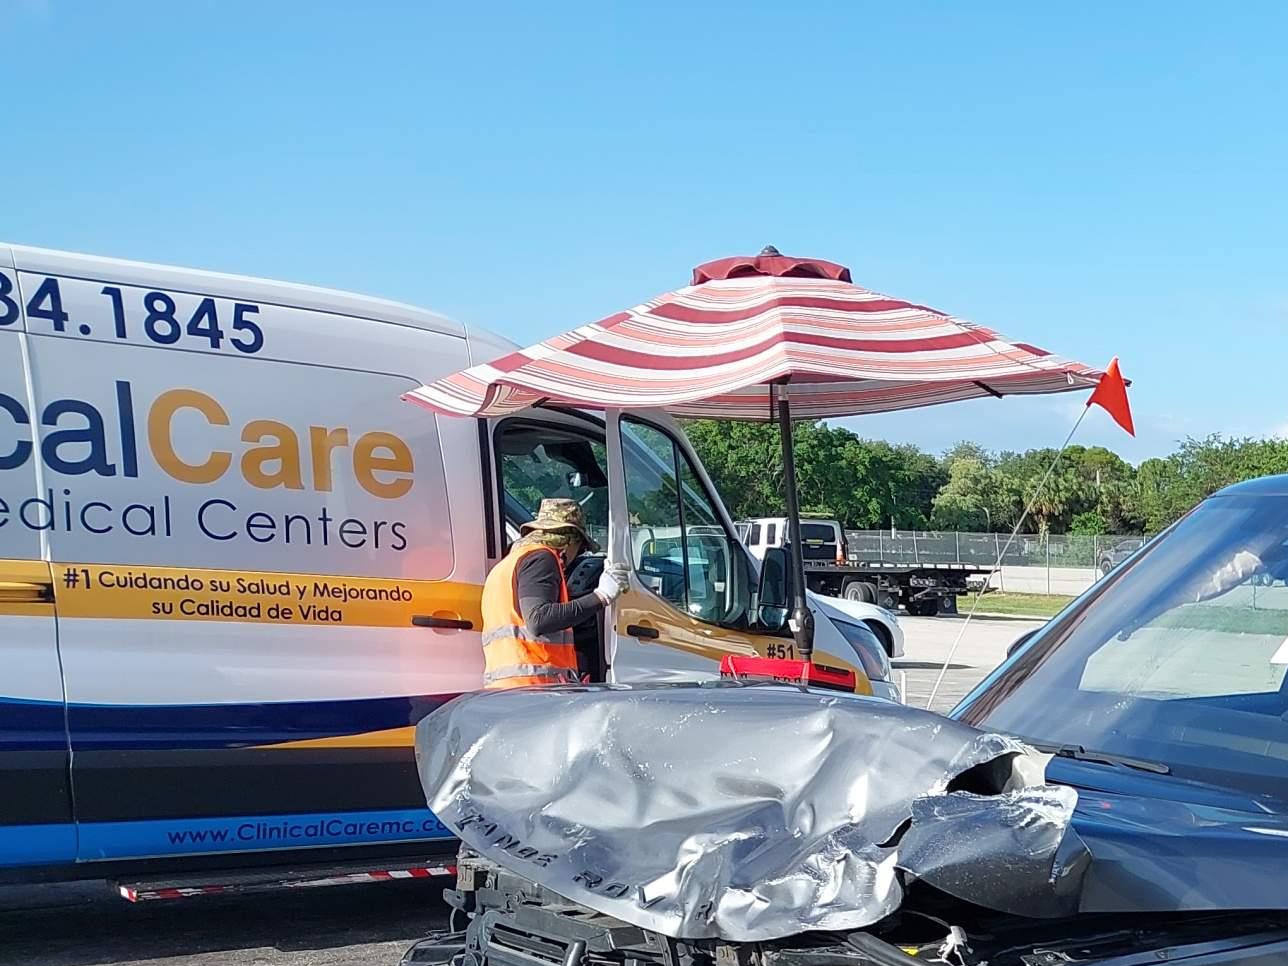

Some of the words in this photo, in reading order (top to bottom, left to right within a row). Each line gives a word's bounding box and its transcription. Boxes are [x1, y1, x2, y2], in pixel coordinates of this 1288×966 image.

[197, 499, 407, 551] Centers
[63, 568, 91, 590] #1
[98, 571, 204, 592] Cuidando
[210, 581, 231, 593] su
[236, 577, 291, 596] Salud
[297, 585, 307, 600] y
[313, 584, 413, 602] Mejorando
[152, 601, 173, 615] su
[180, 599, 261, 619] Calidad
[268, 603, 293, 620] de
[298, 604, 343, 622] Vida
[766, 643, 795, 660] #51
